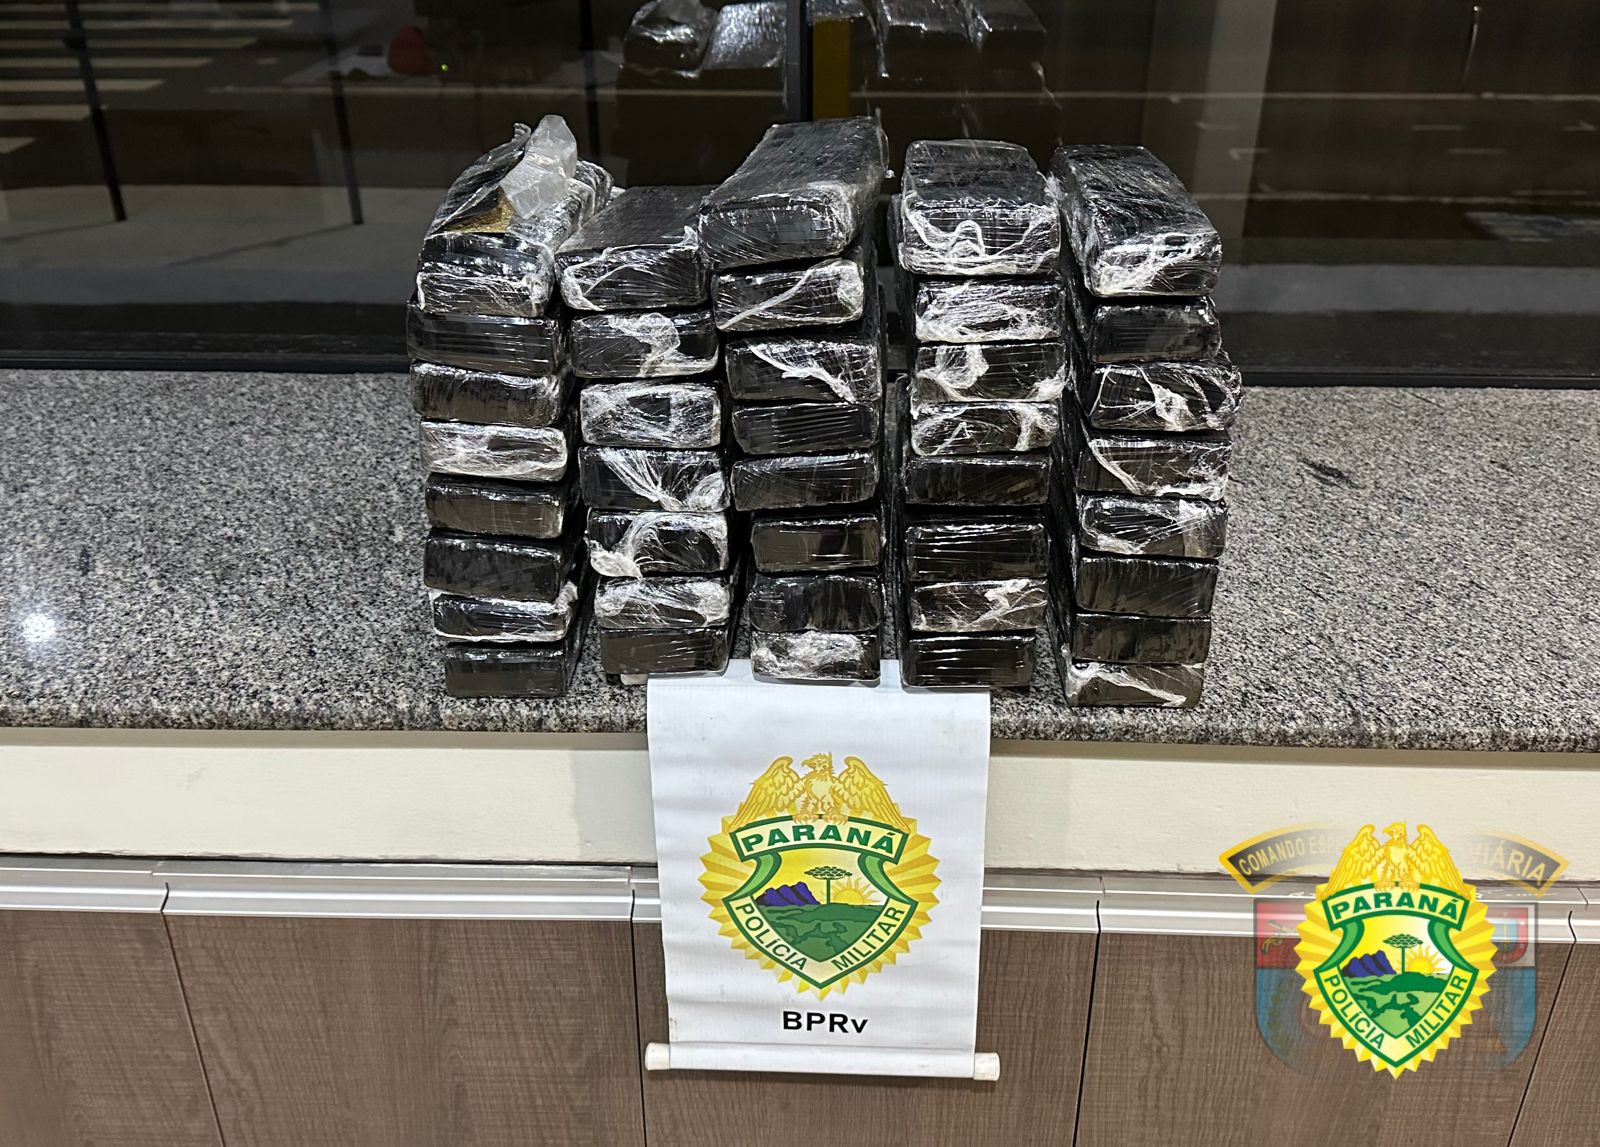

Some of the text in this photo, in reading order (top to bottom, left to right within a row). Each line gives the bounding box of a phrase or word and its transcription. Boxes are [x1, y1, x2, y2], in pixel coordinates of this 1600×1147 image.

[741, 825, 896, 855] PARANÁ
[735, 902, 905, 972] POLÍCIA MILITAR
[782, 1010, 869, 1034] BPRv
